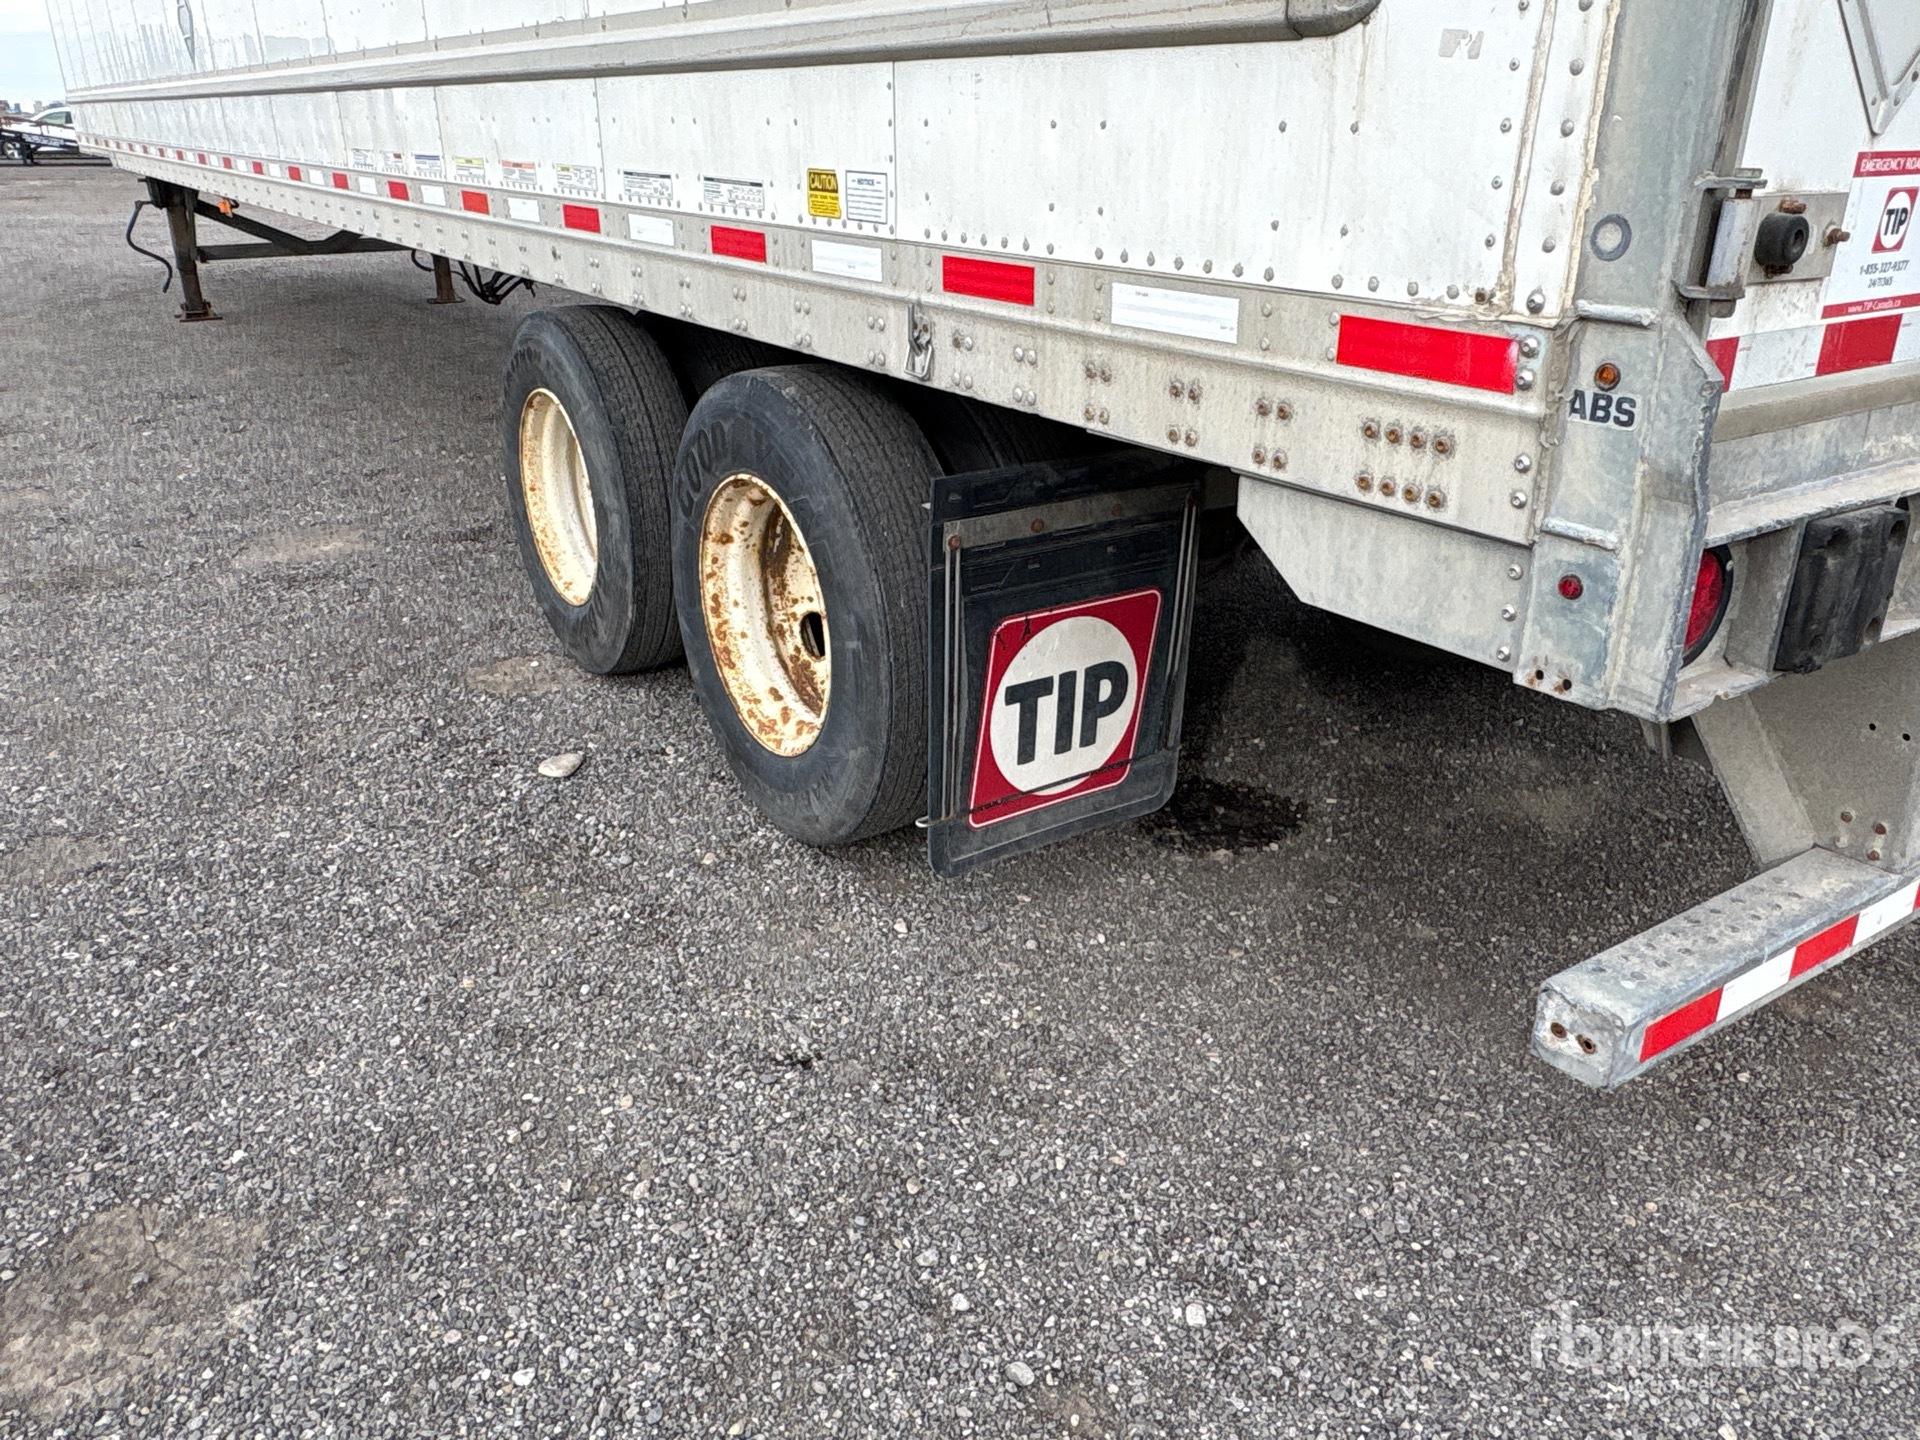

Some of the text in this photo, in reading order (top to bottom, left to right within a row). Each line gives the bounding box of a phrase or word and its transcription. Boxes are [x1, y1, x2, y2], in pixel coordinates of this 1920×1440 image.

[1860, 157, 1905, 172] EMERGENCY
[810, 173, 837, 191] CAUTION
[1884, 207, 1909, 236] TIP
[1568, 389, 1637, 427] ABS
[1004, 661, 1129, 766] TIP
